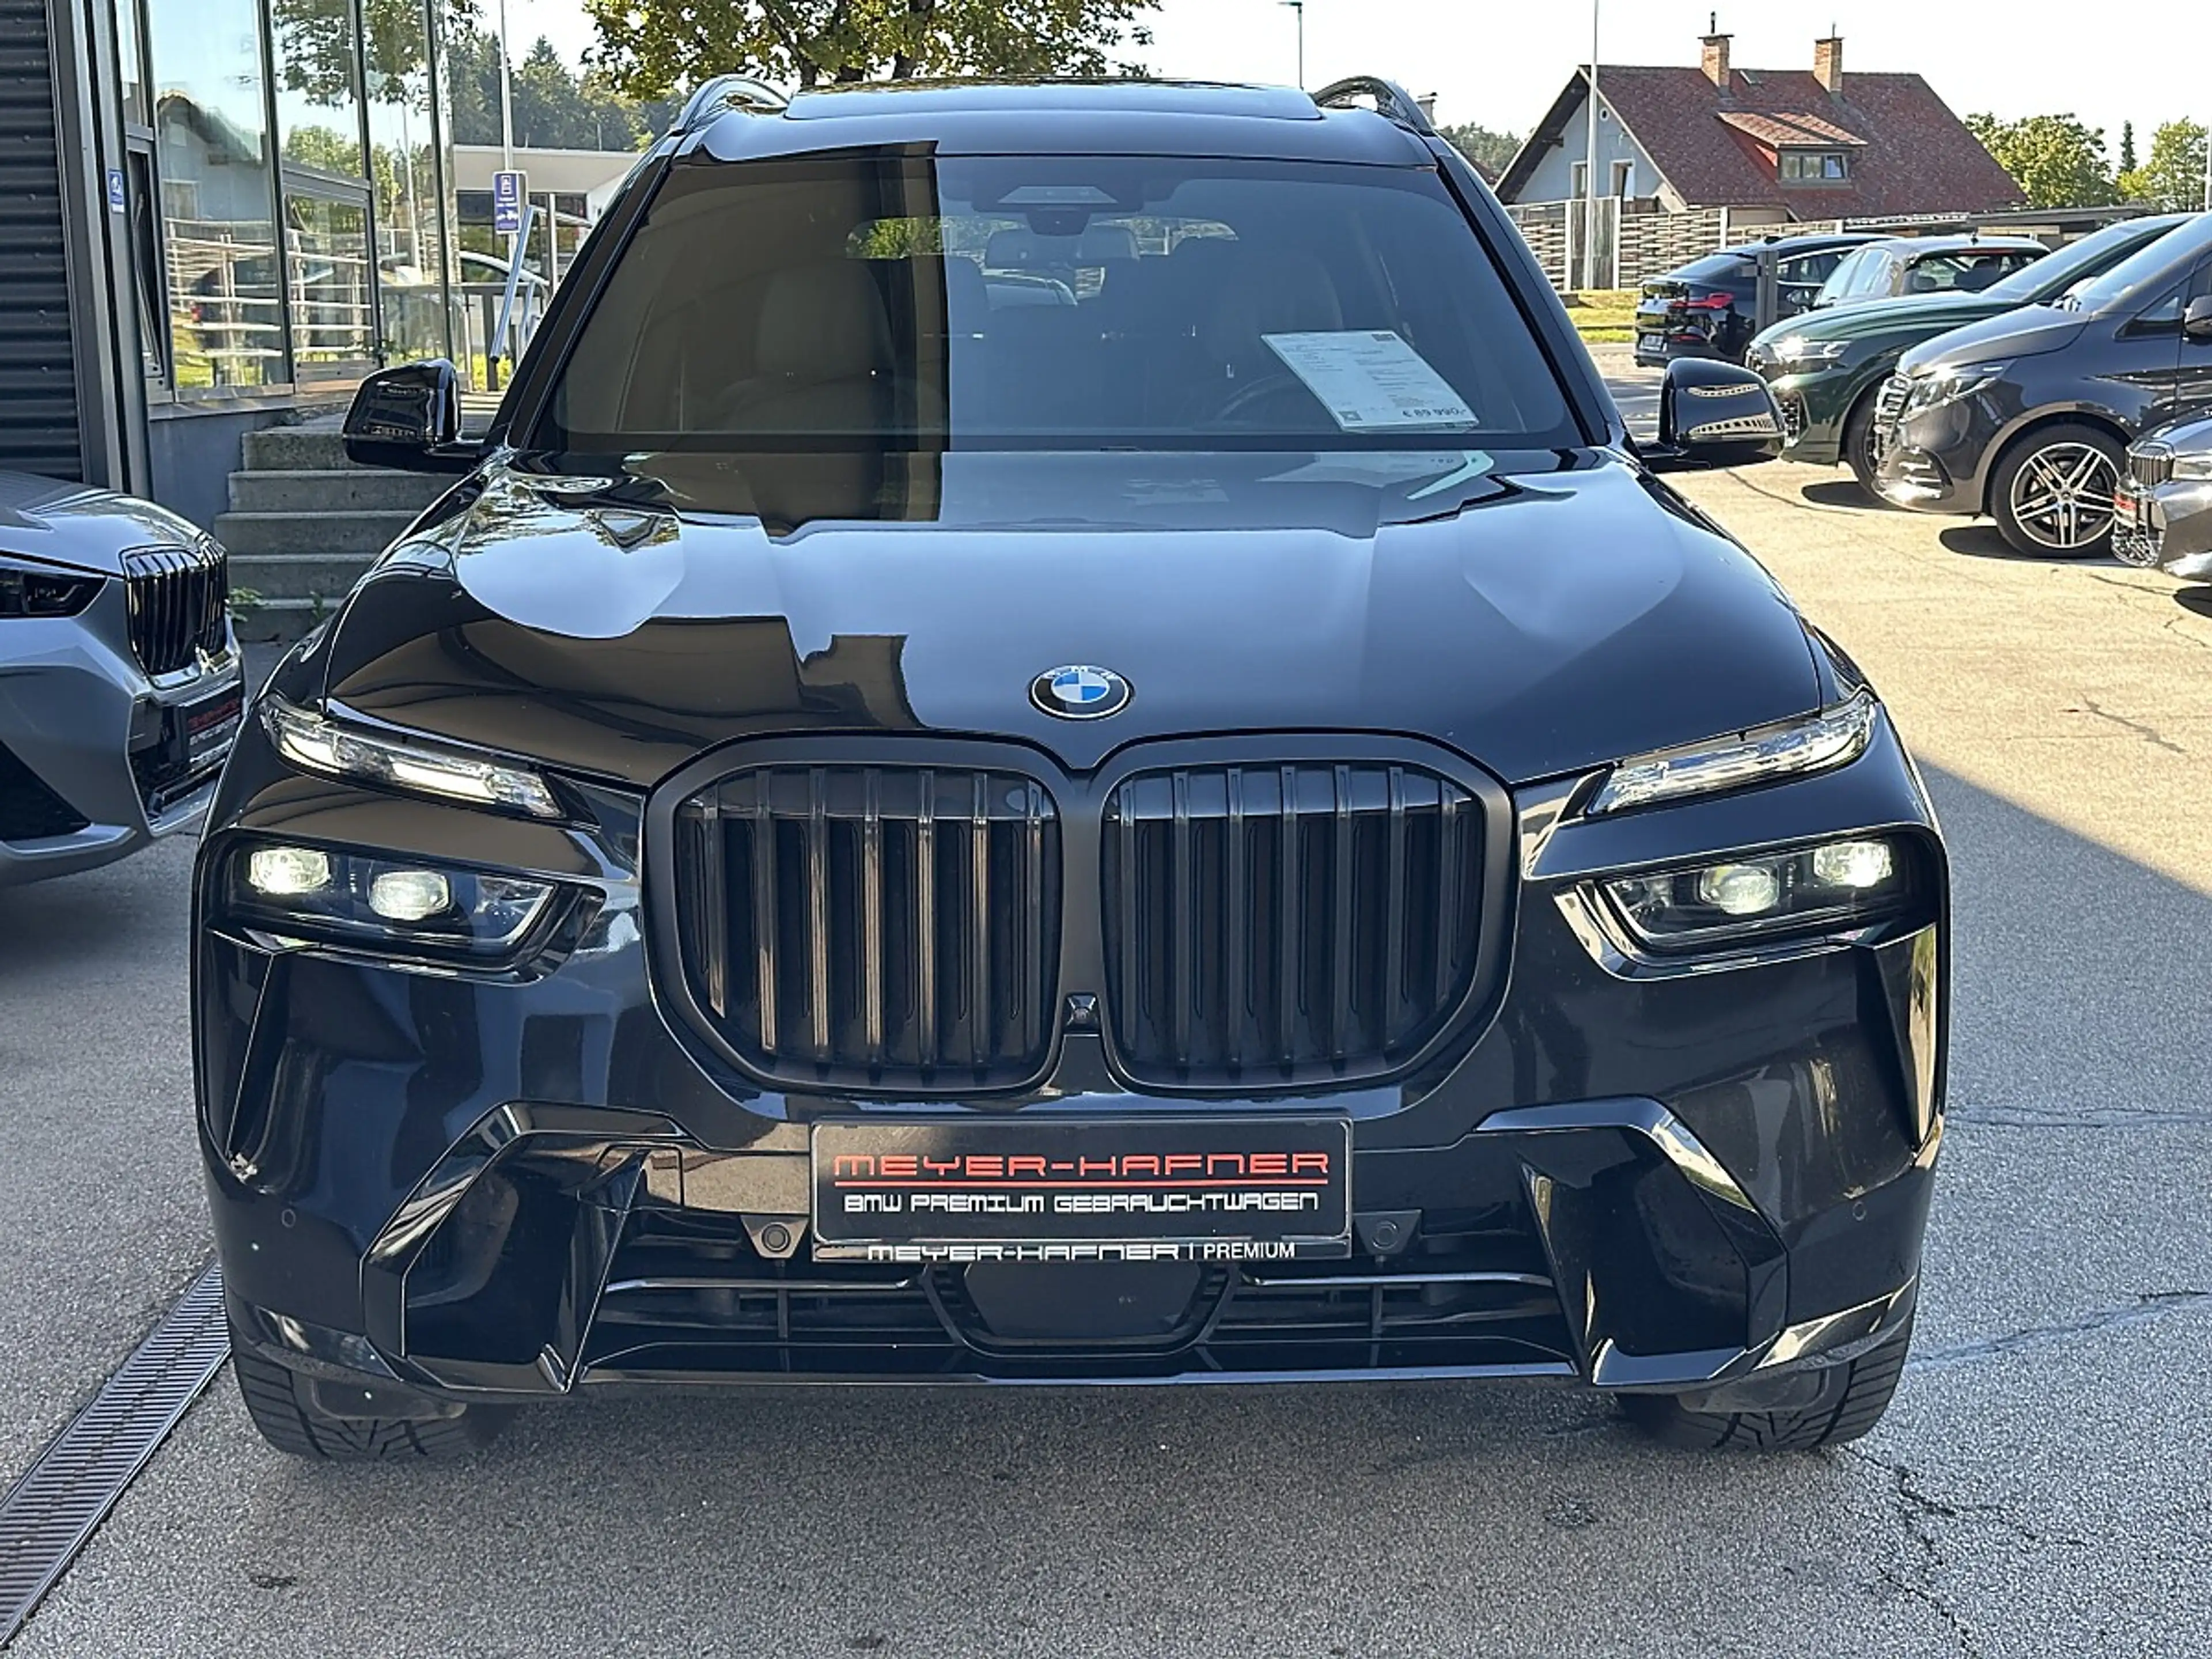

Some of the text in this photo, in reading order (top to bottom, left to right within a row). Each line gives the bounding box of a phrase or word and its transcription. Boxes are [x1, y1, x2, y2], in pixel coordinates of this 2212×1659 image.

[834, 1153, 1328, 1176] MEYER-HAFNER
[844, 1192, 1319, 1213] BMW PREMIUM GEBRAUCHTWAGEN
[868, 1244, 1179, 1262] MEYER-HAFNER
[1203, 1243, 1296, 1260] PREMIUM
